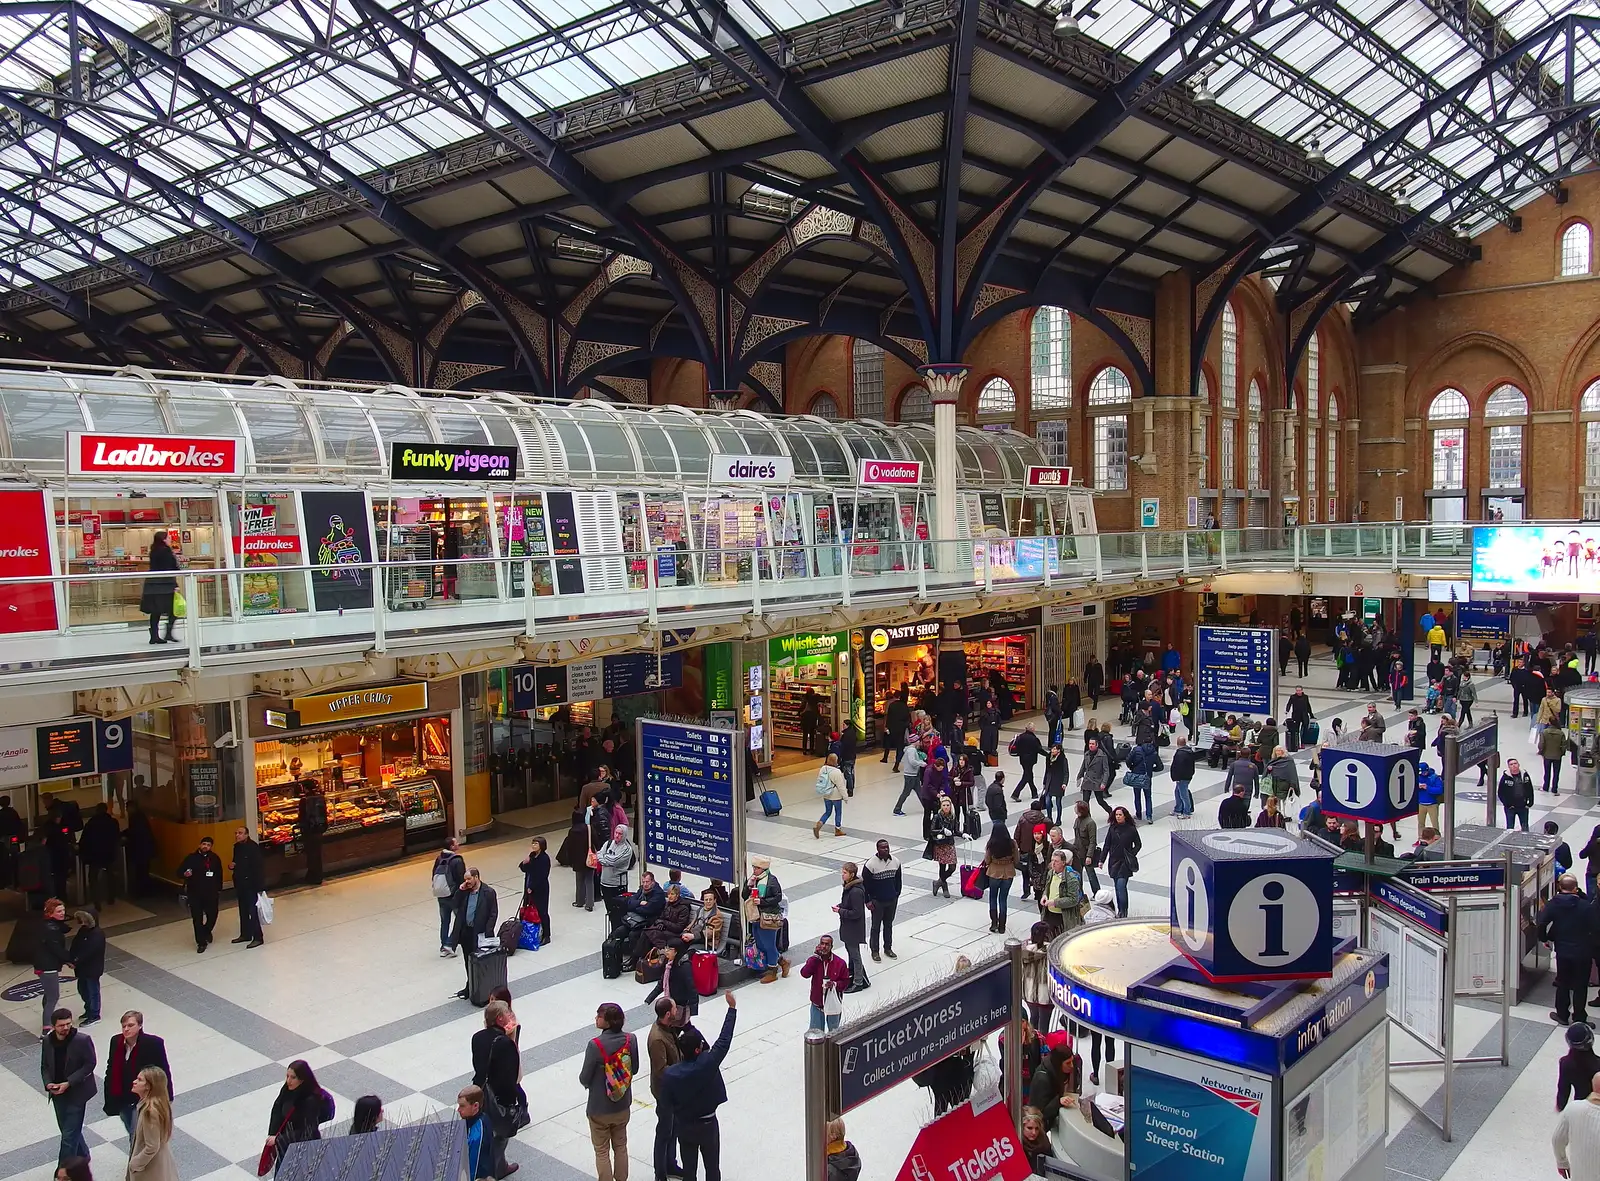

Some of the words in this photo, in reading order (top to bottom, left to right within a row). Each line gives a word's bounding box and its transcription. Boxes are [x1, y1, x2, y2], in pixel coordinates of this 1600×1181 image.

[93, 442, 225, 467] Ladbrokes
[402, 448, 509, 472] funkypigeon
[488, 468, 509, 477] .com
[728, 461, 776, 479] claire's
[880, 467, 915, 479] vodafone
[525, 508, 543, 516] NEW
[248, 517, 274, 530] FREE
[243, 540, 294, 550] adbrokes
[916, 623, 939, 636] SHOP
[781, 634, 837, 652] Whistlestop
[514, 672, 534, 693] 10
[572, 690, 594, 698] departure
[328, 693, 361, 712] UPPER
[363, 692, 393, 705] CRUST
[105, 724, 124, 749] 9
[685, 731, 702, 740] Toilets
[652, 750, 670, 759] Tickets
[693, 744, 703, 752] Lift
[681, 766, 693, 776] Way
[693, 769, 703, 777] out
[665, 775, 676, 784] First
[676, 777, 686, 785] Aid
[666, 787, 689, 798] Customer
[689, 792, 707, 802] lounge
[666, 799, 684, 809] Station
[684, 804, 708, 813] reception
[666, 811, 679, 820] Cycle
[666, 822, 677, 831] First
[677, 825, 691, 834] Class
[691, 828, 708, 838] lounge
[667, 834, 677, 843] Left
[677, 836, 696, 847] luggage
[667, 846, 692, 858] Accessible
[692, 851, 708, 861] toilets
[667, 857, 680, 867] Taxis
[1410, 876, 1430, 885] Train
[1432, 874, 1479, 884] Departures
[1388, 891, 1400, 904] Train
[1400, 897, 1427, 919] departures
[862, 1000, 962, 1062] TicketXpress
[1297, 995, 1352, 1052] information
[863, 1063, 895, 1087] Collect
[897, 1053, 918, 1072] your
[920, 1029, 957, 1061] pre-paid
[959, 1014, 988, 1037] tickets
[990, 1004, 1008, 1022] here
[1200, 1076, 1263, 1100] NetworkRail
[1145, 1097, 1178, 1116] Welcome
[1181, 1109, 1190, 1119] to
[1145, 1113, 1198, 1140] Liverpool
[1145, 1131, 1180, 1151] Street
[1182, 1141, 1225, 1166] Station
[947, 1136, 1015, 1181] Tickets
